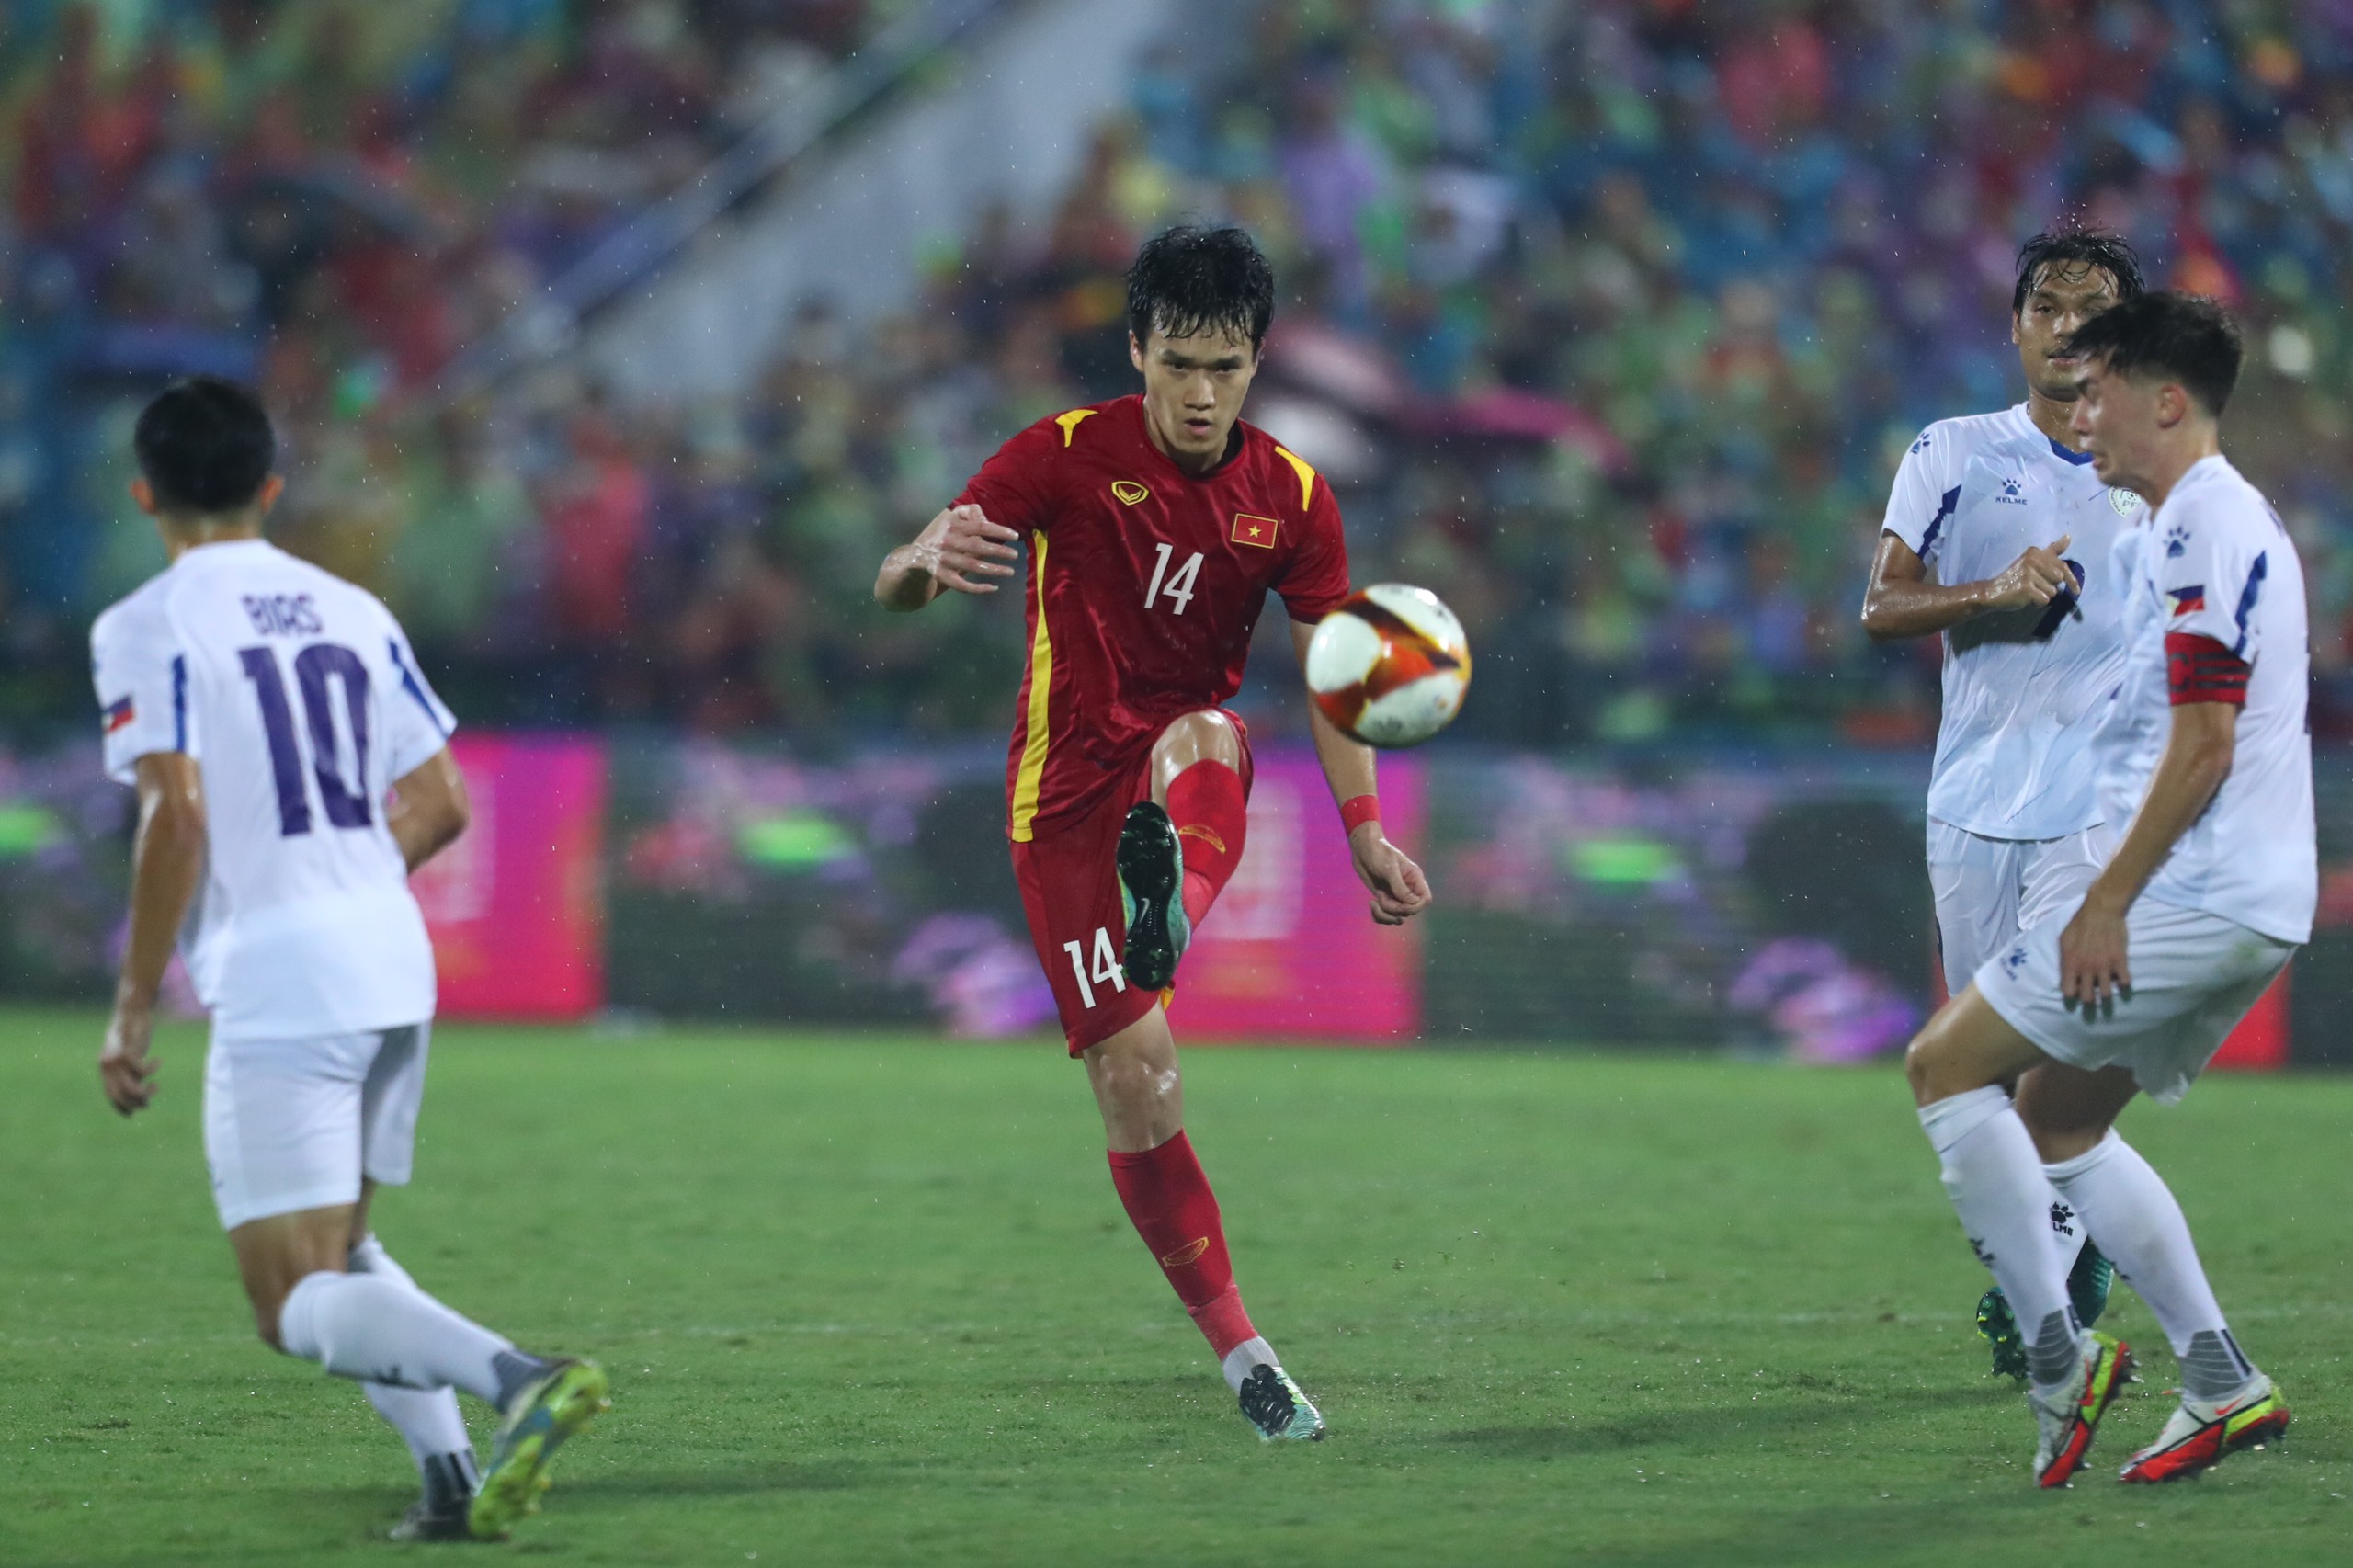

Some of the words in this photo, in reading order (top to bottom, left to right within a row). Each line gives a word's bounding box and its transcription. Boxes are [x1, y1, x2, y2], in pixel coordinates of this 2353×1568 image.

[1995, 496, 2028, 506] KELME
[1144, 542, 1205, 615] 14
[238, 643, 373, 836] 10
[1063, 926, 1126, 1009] 14
[2052, 1221, 2074, 1237] LME
